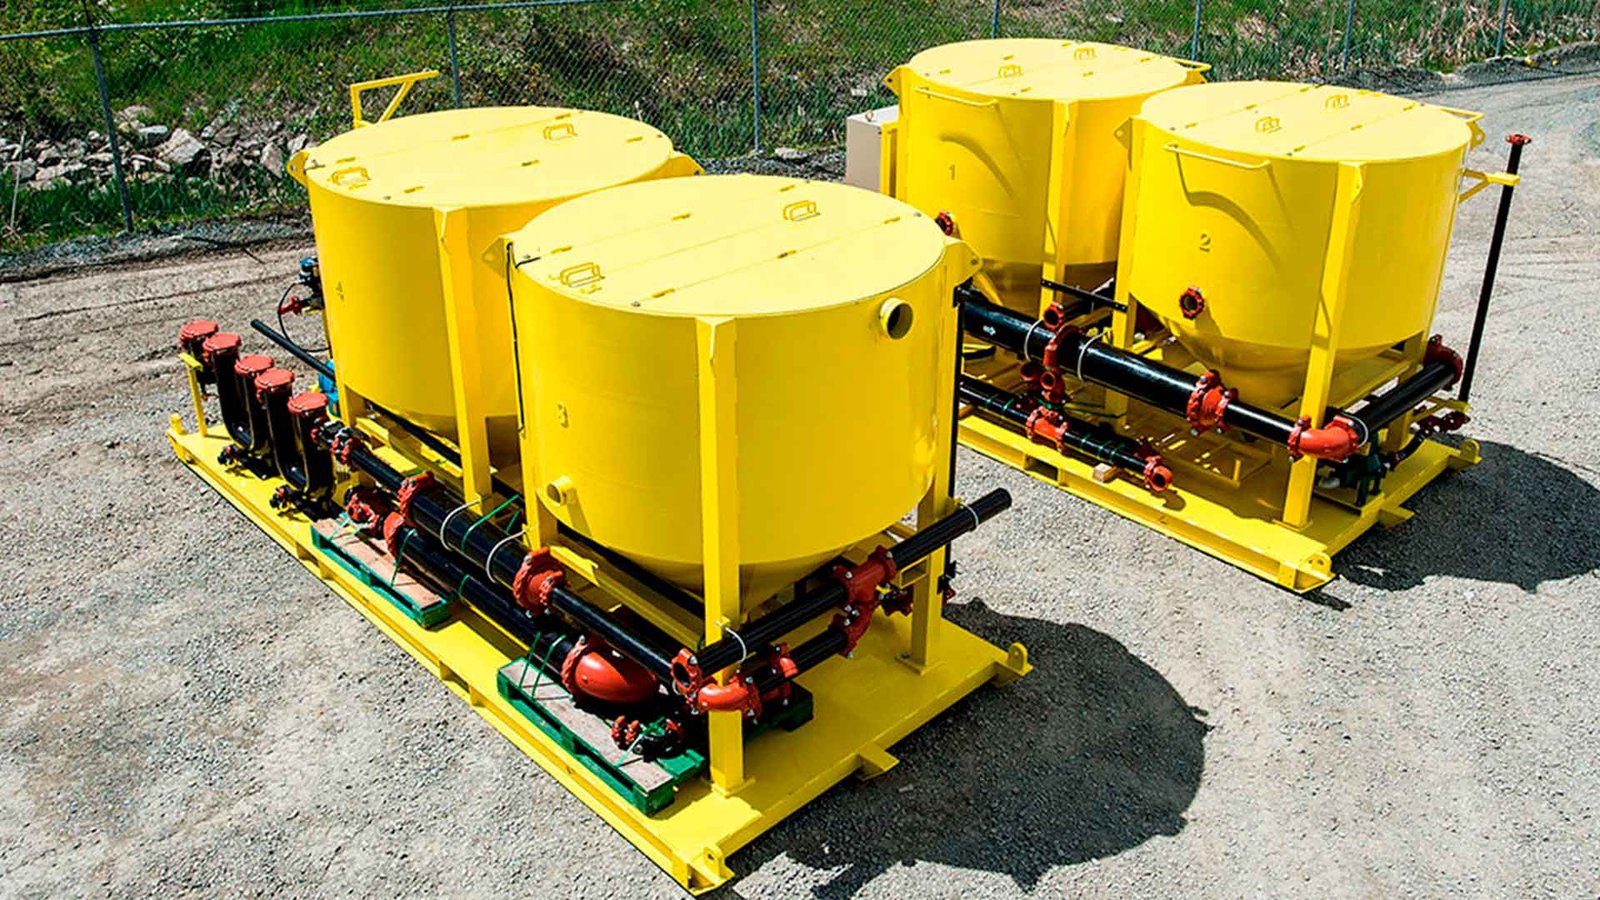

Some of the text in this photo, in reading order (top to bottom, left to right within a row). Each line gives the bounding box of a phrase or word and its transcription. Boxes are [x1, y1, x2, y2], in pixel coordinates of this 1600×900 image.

[948, 164, 956, 181] 1
[1199, 234, 1211, 252] 2
[557, 404, 569, 429] 3
